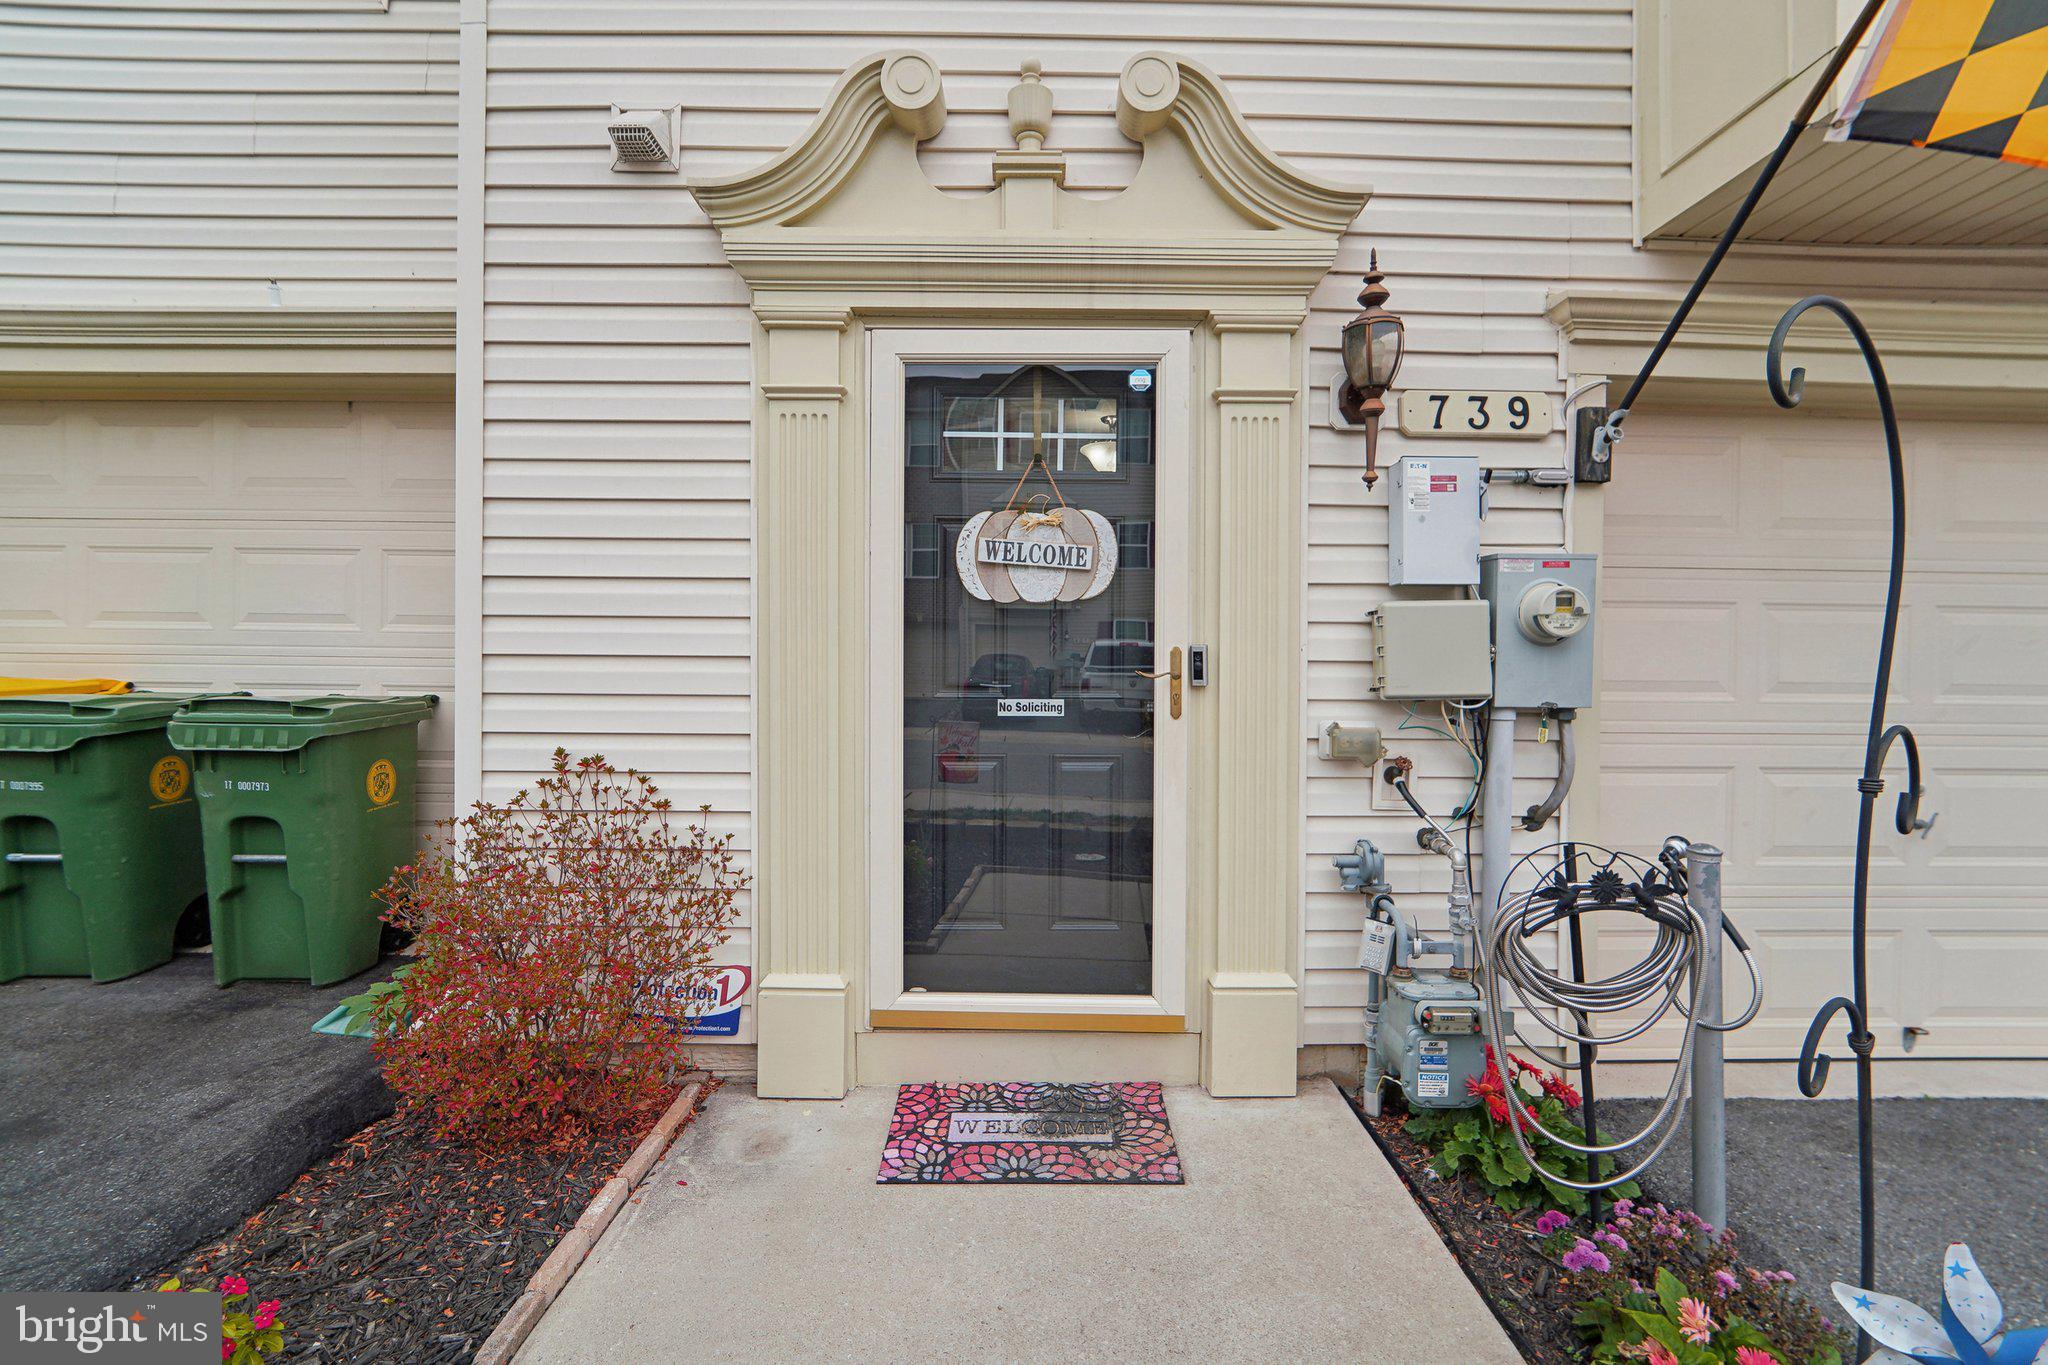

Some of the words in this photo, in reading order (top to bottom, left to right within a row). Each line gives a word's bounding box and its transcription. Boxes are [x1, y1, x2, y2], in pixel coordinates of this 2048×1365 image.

[1429, 395, 1530, 430] 739
[984, 539, 1088, 569] WELCOME
[999, 702, 1012, 712] No
[1015, 702, 1063, 714] Soliciting
[237, 781, 270, 791] 0007973
[631, 979, 718, 1000] otcion
[955, 1118, 1109, 1135] WELCOME
